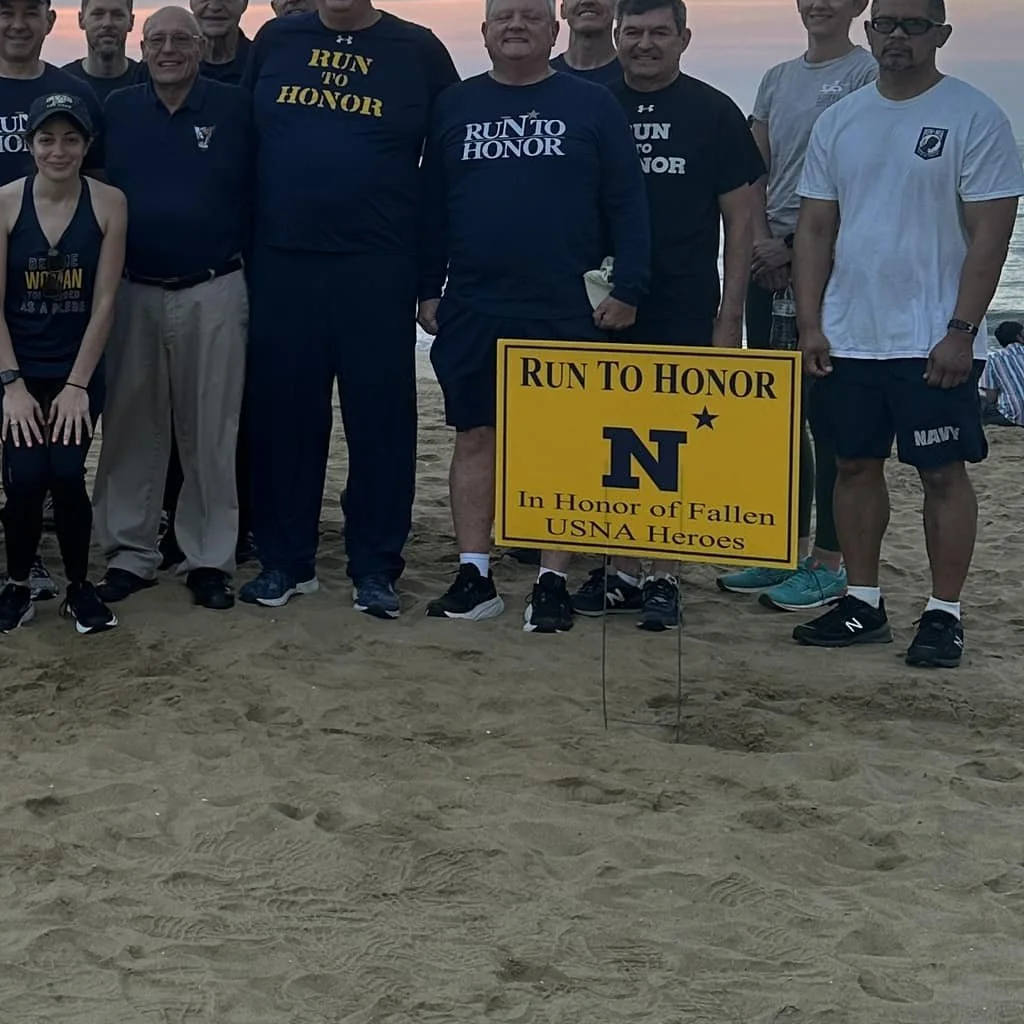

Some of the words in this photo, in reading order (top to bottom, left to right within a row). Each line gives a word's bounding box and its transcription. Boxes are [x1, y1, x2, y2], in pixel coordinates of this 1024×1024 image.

[308, 49, 373, 75] RUN
[321, 71, 348, 86] TO
[276, 86, 382, 116] HONOR
[465, 115, 528, 141] RUN
[530, 119, 566, 137] TO
[629, 123, 671, 140] UN
[461, 137, 566, 160] HONOR
[914, 426, 960, 446] NAVY
[601, 426, 688, 492] N
[518, 491, 544, 509] In
[554, 493, 641, 516] Honor
[650, 501, 682, 519] of
[687, 502, 775, 526] Fallen
[545, 517, 636, 541] USNA
[646, 524, 745, 550] Heroes
[845, 617, 863, 632] N
